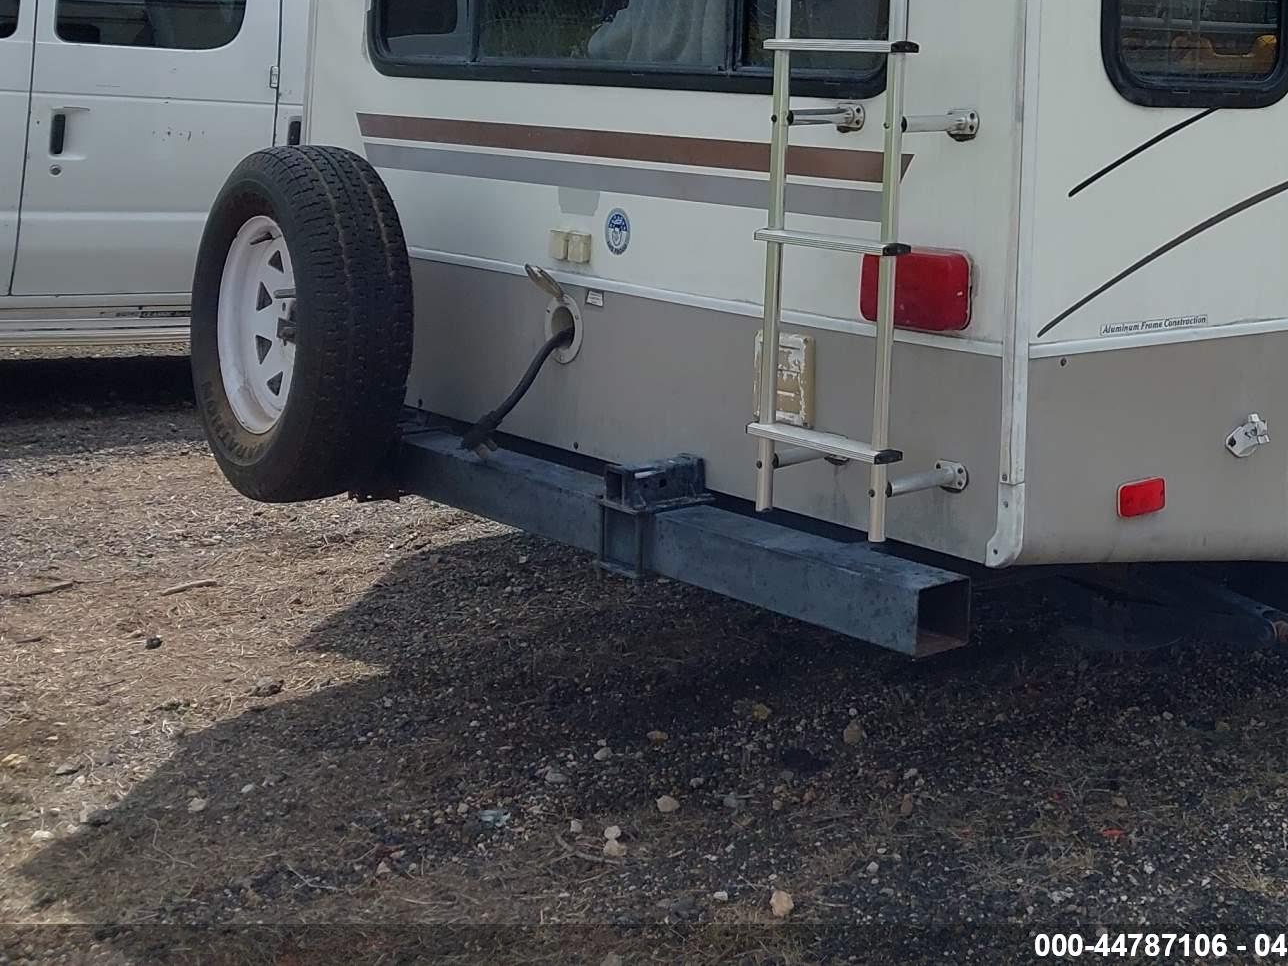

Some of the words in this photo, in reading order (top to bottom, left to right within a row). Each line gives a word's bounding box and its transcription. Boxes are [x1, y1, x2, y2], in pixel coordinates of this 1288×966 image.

[1102, 324, 1139, 334] Aluminum
[1141, 321, 1162, 330] Frame
[1164, 316, 1206, 328] Construction
